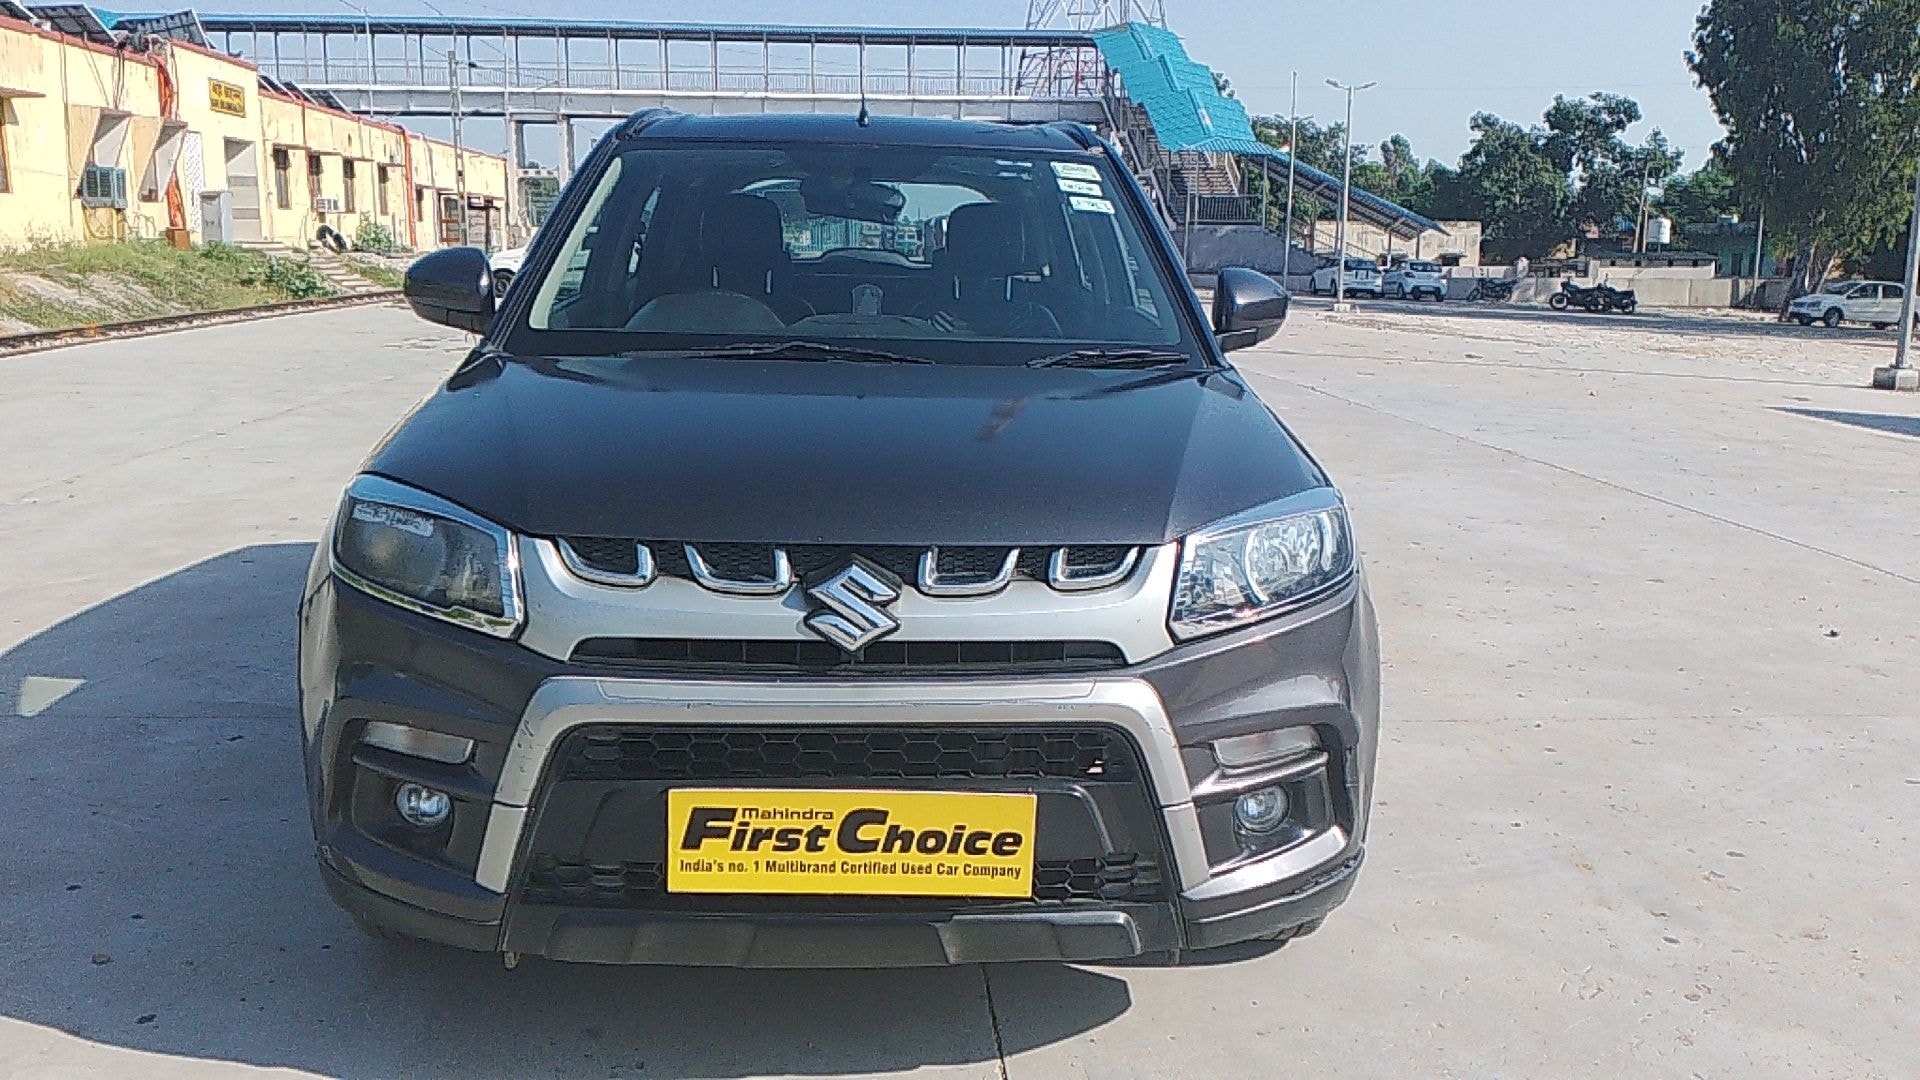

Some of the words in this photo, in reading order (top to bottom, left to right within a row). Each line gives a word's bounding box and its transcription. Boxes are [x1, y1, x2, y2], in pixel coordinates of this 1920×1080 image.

[741, 807, 834, 820] Mahindra
[680, 806, 832, 852] First
[837, 807, 1023, 856] Choice
[680, 859, 724, 873] India's
[728, 863, 749, 873] no.
[753, 860, 760, 873] 1
[765, 860, 836, 874] Multibrand
[840, 860, 896, 875] Certified
[901, 862, 932, 875] Used
[936, 863, 958, 876] Car
[963, 863, 1021, 880] Company
